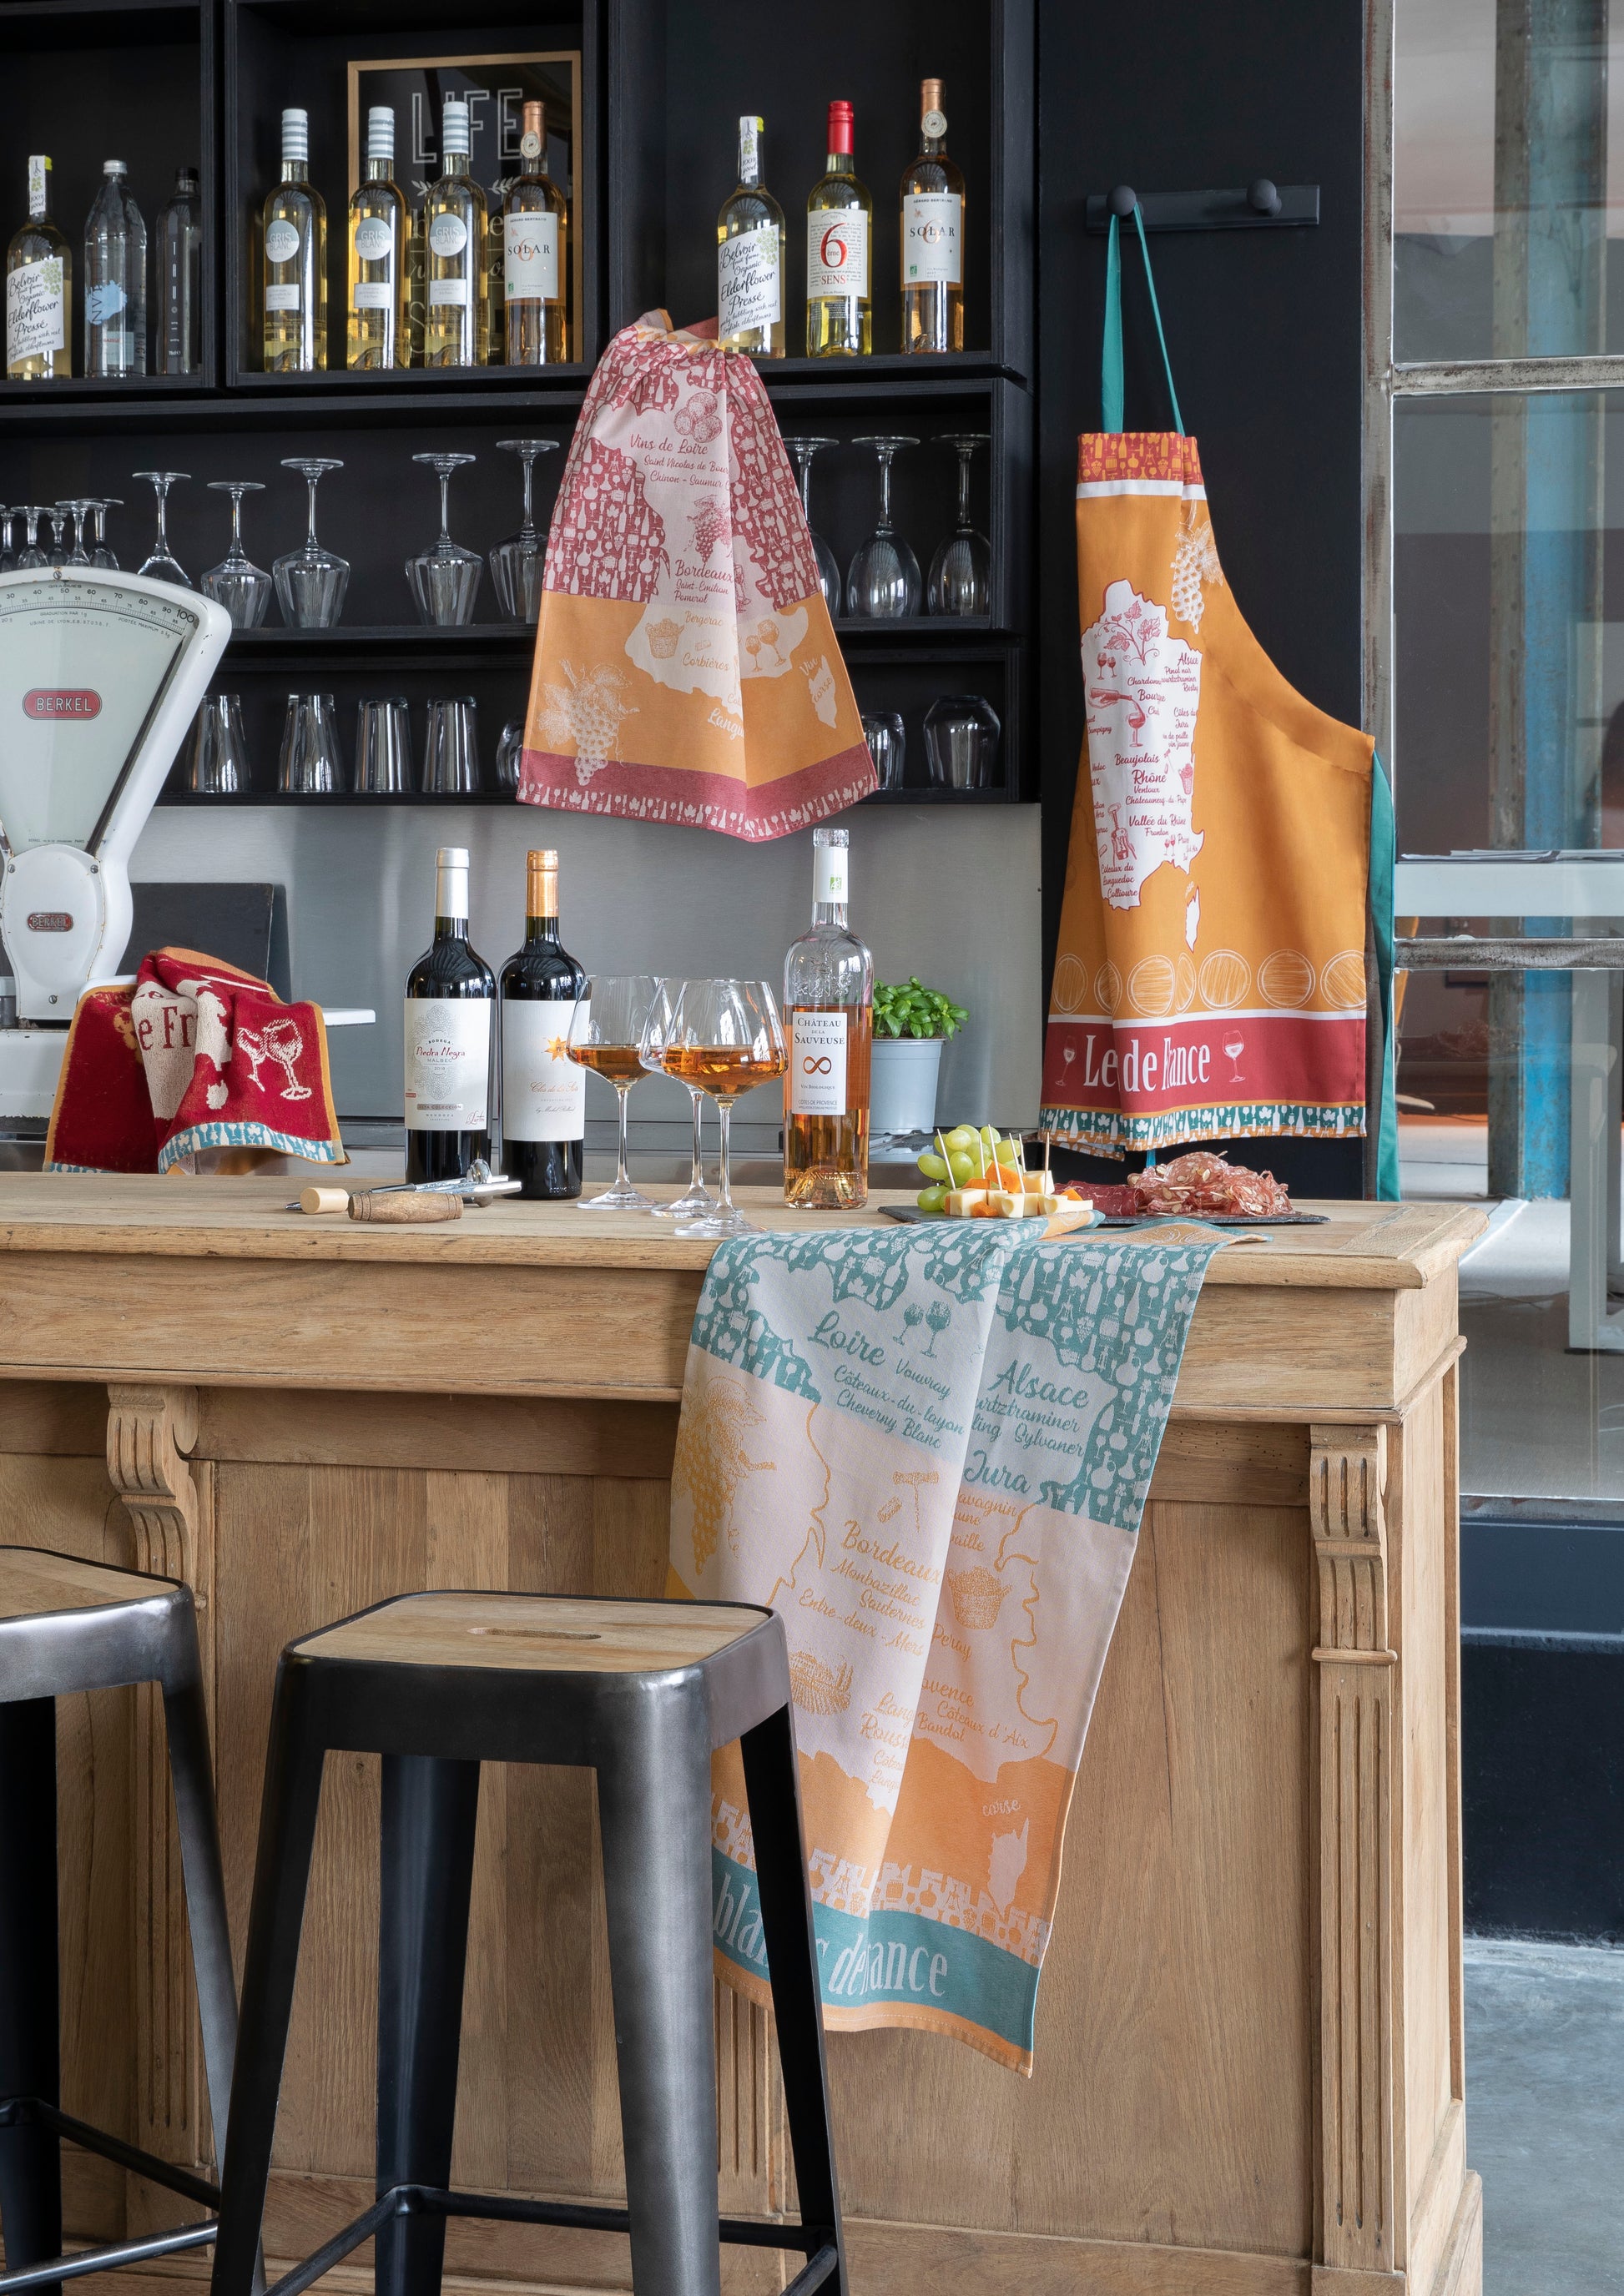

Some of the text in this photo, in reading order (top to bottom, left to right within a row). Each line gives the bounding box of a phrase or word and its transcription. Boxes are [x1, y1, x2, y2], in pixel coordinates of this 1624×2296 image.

[412, 88, 523, 164] LFE
[270, 232, 292, 244] GRIS
[361, 230, 386, 241] GRIS
[436, 226, 459, 237] GRIS
[910, 226, 955, 237] SOLAR
[270, 241, 291, 250] BLANC
[361, 239, 385, 249] BLANC
[436, 235, 459, 245] BLANC
[821, 223, 847, 268] 6
[507, 244, 551, 256] SOLAR
[719, 242, 758, 273] Belvoir
[734, 260, 762, 277] Organic
[8, 273, 42, 297] Belvoir
[721, 270, 776, 301] Elderflower
[821, 274, 846, 285] SENS
[18, 290, 45, 305] Organic
[728, 292, 765, 316] Pressé
[8, 300, 59, 328] Elderflower
[14, 320, 48, 341] Pressé
[630, 434, 708, 455] Vins de Loire
[644, 455, 664, 466] Saint
[667, 458, 694, 471] Nicolas
[697, 461, 707, 471] de
[650, 470, 679, 483] Chinon
[689, 476, 724, 488] Saumur
[674, 559, 734, 583] Bordeaux
[674, 590, 708, 604] Pomerol
[177, 609, 194, 623] 100
[684, 611, 724, 627] Bergerac
[139, 622, 159, 633] MAXIMUM
[682, 652, 729, 672] Corbières
[799, 657, 820, 676] Vin
[1178, 652, 1198, 666] Alsace
[1164, 667, 1180, 675] Pinot
[813, 676, 834, 703] corse
[36, 697, 93, 712] BERKEL
[1175, 718, 1189, 729] Jura
[1114, 753, 1160, 768] Beaujolais
[1132, 769, 1167, 785] Rhône
[1129, 814, 1156, 827] Vallée
[1157, 813, 1168, 826] du
[1145, 827, 1169, 838] Fronton
[1124, 863, 1134, 872] du
[1107, 888, 1138, 899] Collioure
[32, 917, 68, 928] BERKEL
[798, 1017, 841, 1028] CHÂTEAU
[794, 1032, 845, 1045] SAUVEUSE
[416, 1045, 466, 1060] Piedra Negra
[1123, 1039, 1158, 1093] de
[807, 1310, 886, 1366] Loire
[895, 1358, 951, 1401] Vouvray
[987, 1358, 1089, 1409] Alsace
[836, 1388, 943, 1449] Cheverny Blanc
[963, 1449, 1032, 1494] Jura
[841, 1519, 941, 1585] Bordeaux
[859, 1588, 926, 1629] Sauternes
[936, 1700, 986, 1735] Côteaux
[918, 1711, 966, 1743] Bandol
